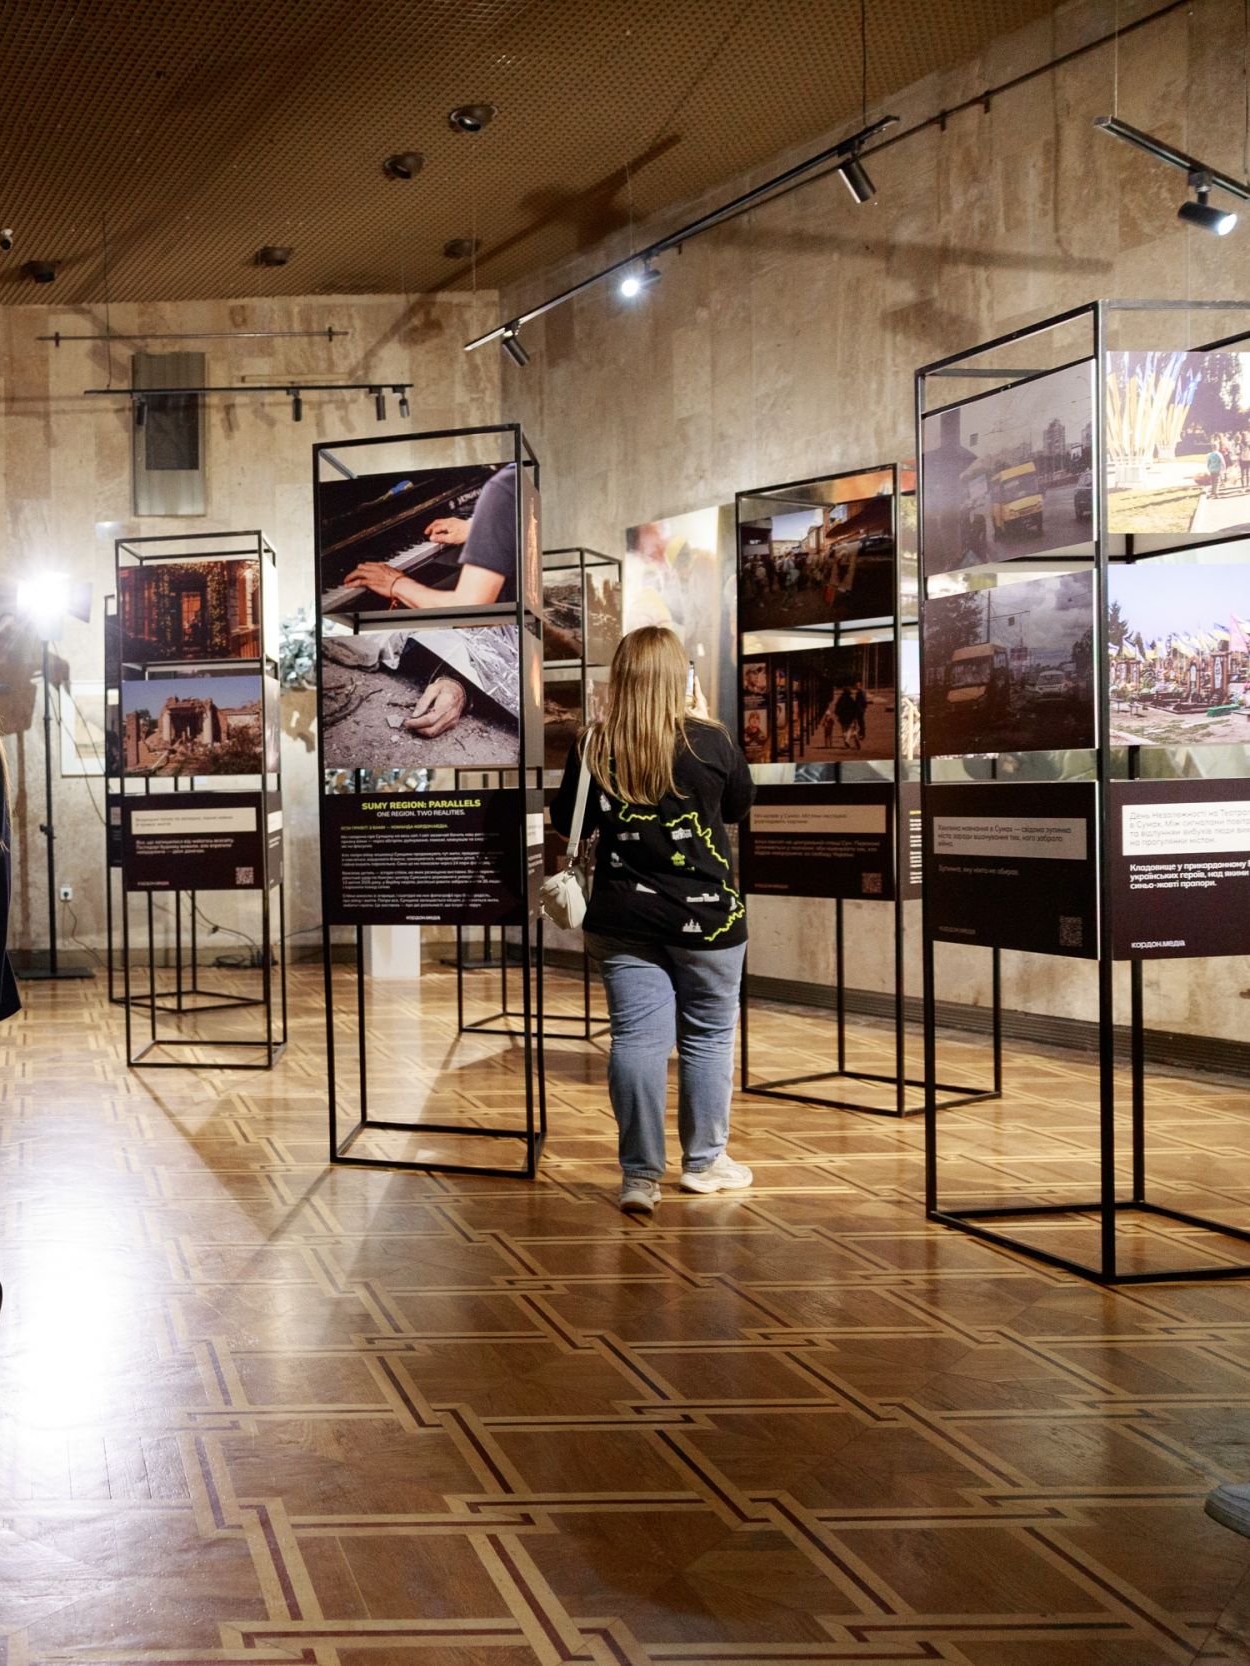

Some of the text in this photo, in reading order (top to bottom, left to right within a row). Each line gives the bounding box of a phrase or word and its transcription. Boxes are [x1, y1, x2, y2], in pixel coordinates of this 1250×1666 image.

[361, 799, 481, 810] SUMY REGION: PARALLELS
[1130, 864, 1177, 872] Кладовище
